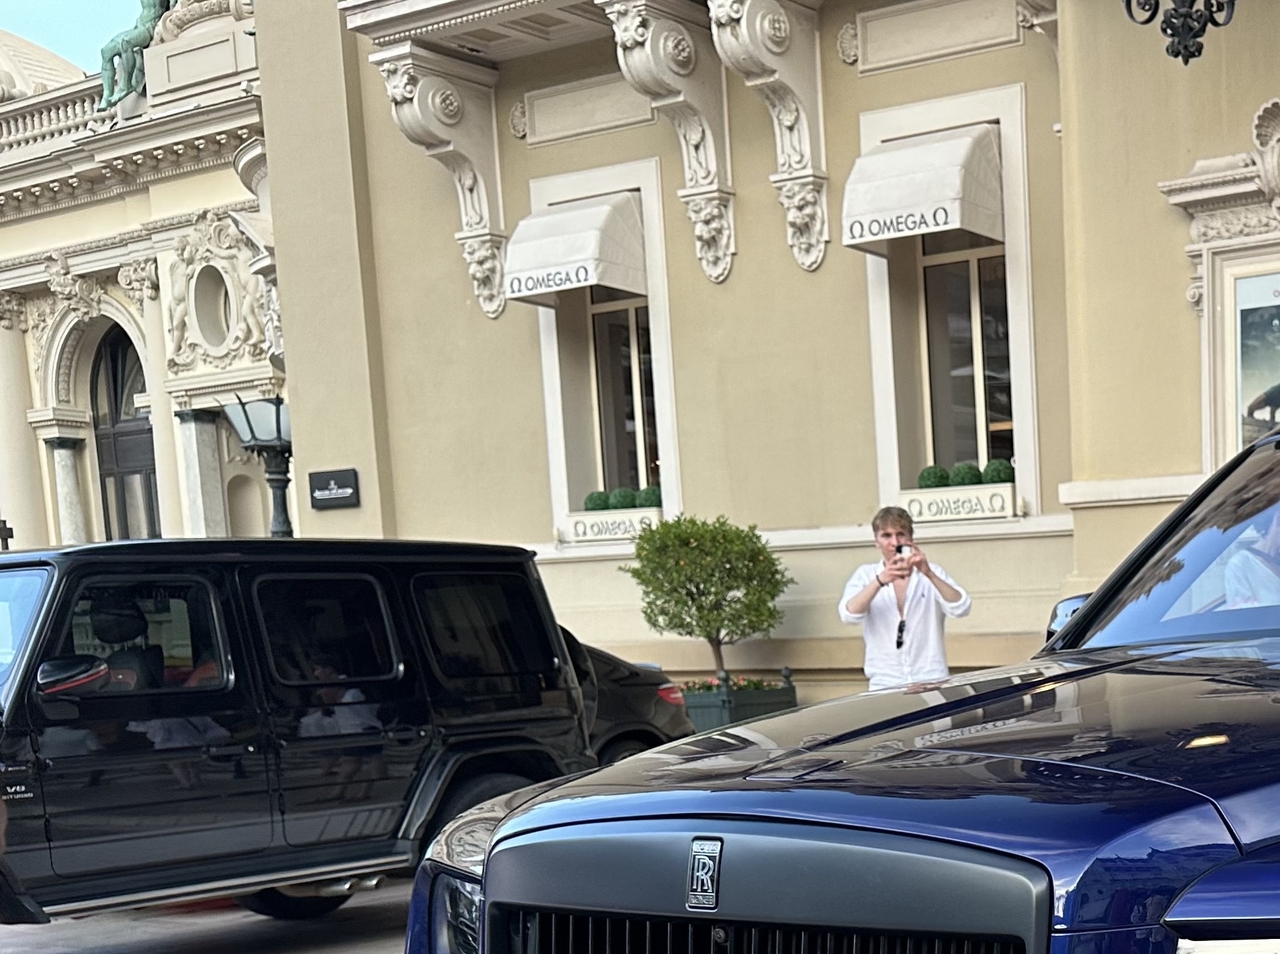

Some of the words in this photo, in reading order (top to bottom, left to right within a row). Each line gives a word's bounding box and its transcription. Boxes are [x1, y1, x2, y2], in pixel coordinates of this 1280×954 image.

[868, 213, 929, 236] OMEGA
[524, 271, 573, 291] OMEGA
[927, 495, 985, 517] OMEGA
[590, 518, 637, 537] OMEGA
